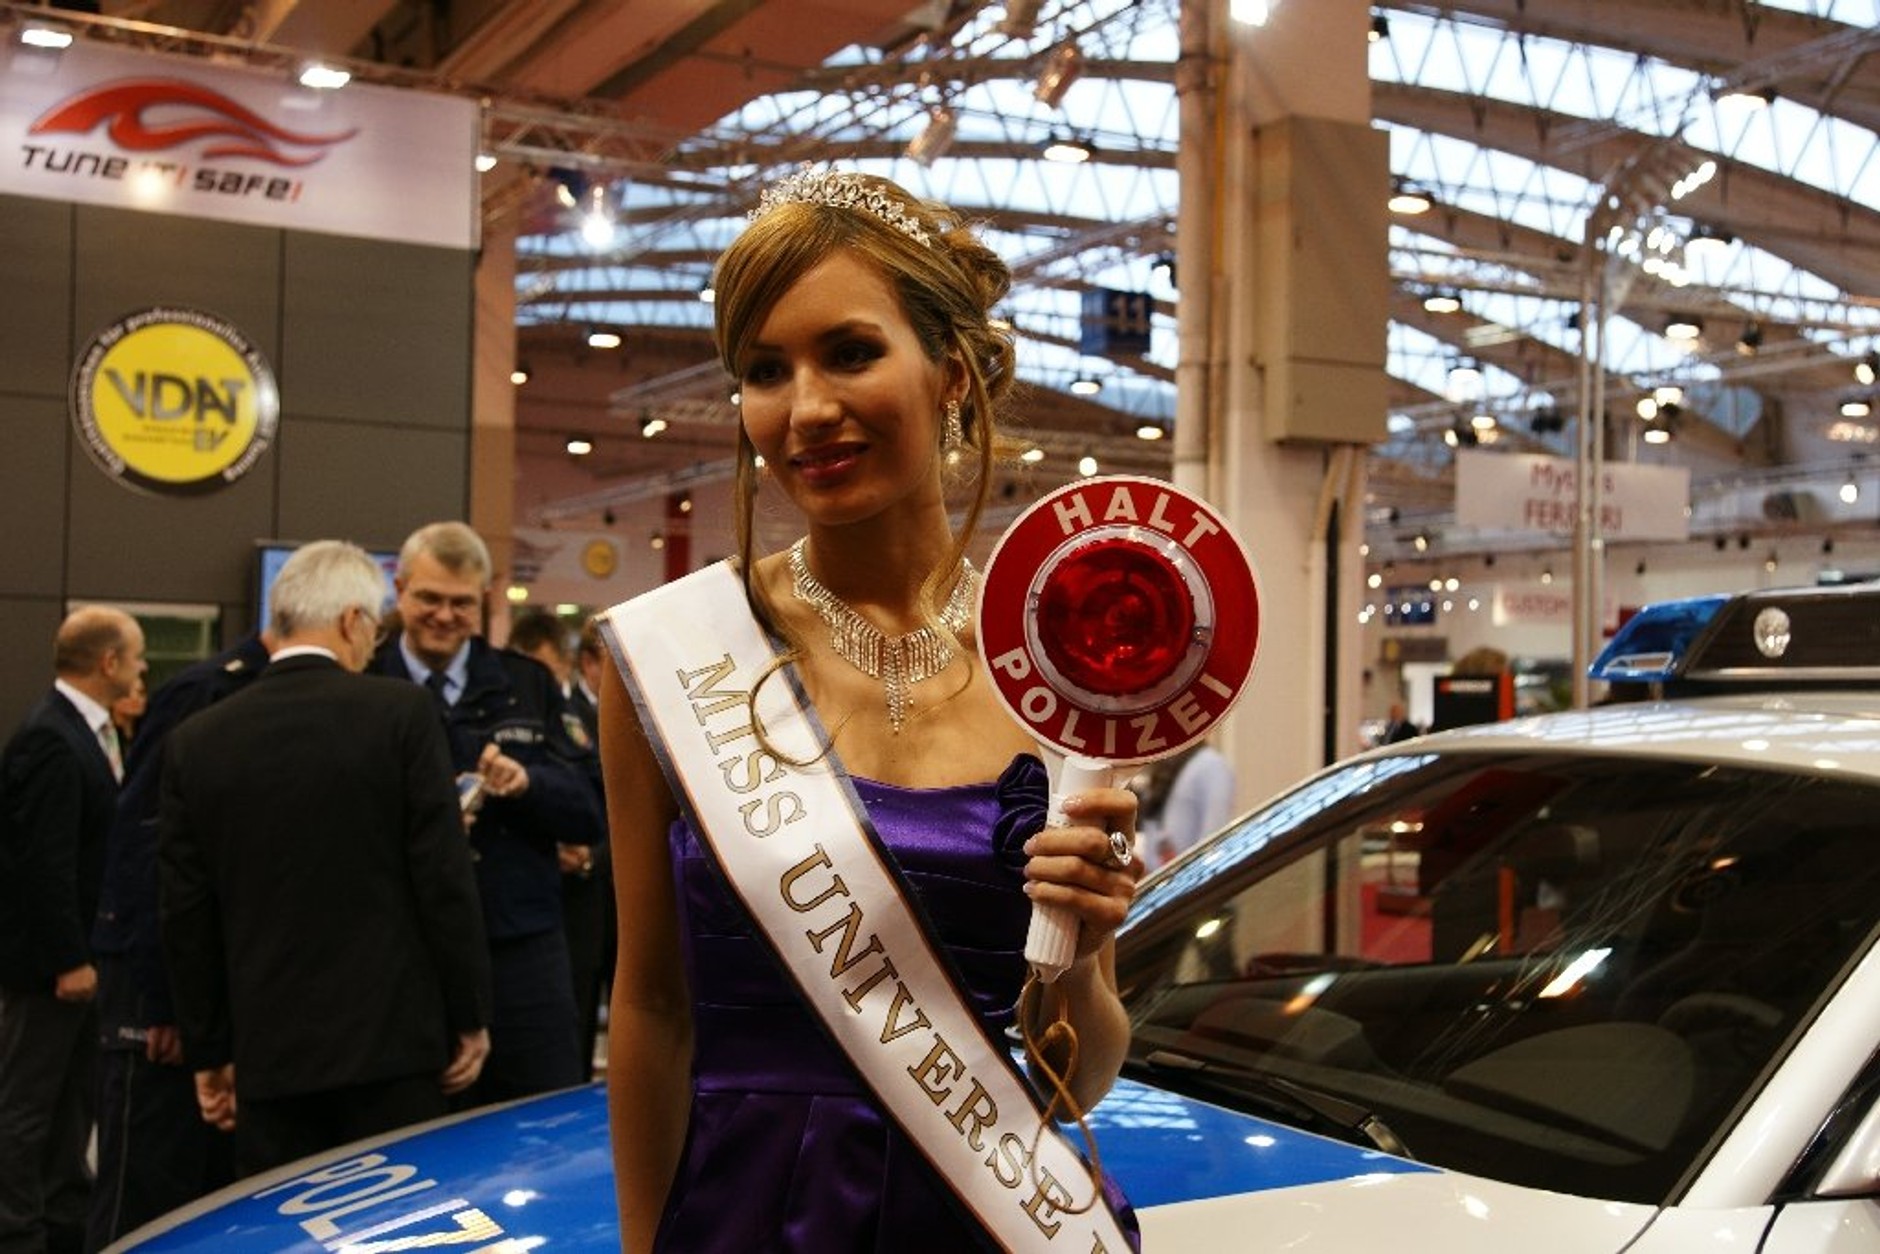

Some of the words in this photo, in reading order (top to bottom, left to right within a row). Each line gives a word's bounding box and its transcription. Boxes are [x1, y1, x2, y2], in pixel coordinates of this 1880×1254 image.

[103, 366, 246, 427] VDAT
[1052, 486, 1219, 549] HALT
[991, 646, 1233, 755] POLIZEI
[676, 652, 808, 838] MISS
[778, 842, 1074, 1241] UNIVERSE
